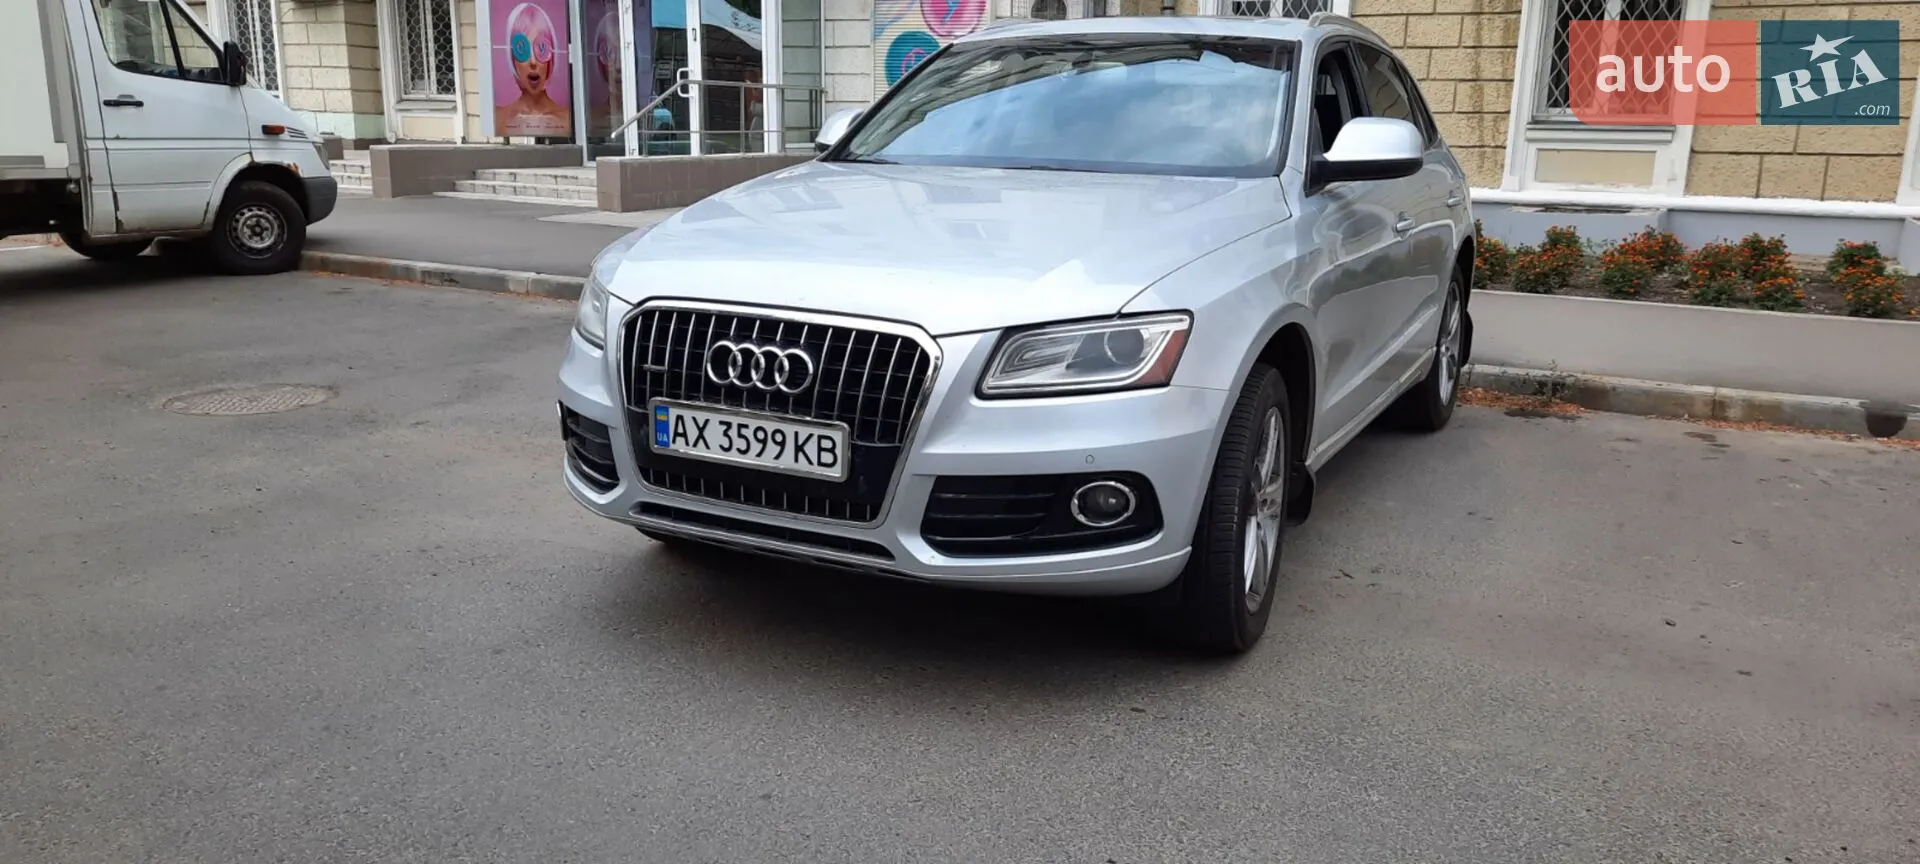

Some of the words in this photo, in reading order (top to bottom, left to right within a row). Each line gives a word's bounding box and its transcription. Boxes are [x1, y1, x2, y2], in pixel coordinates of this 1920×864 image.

[656, 431, 669, 443] UA
[672, 414, 711, 450] AX
[718, 420, 787, 460] 3599
[793, 430, 838, 468] KB
